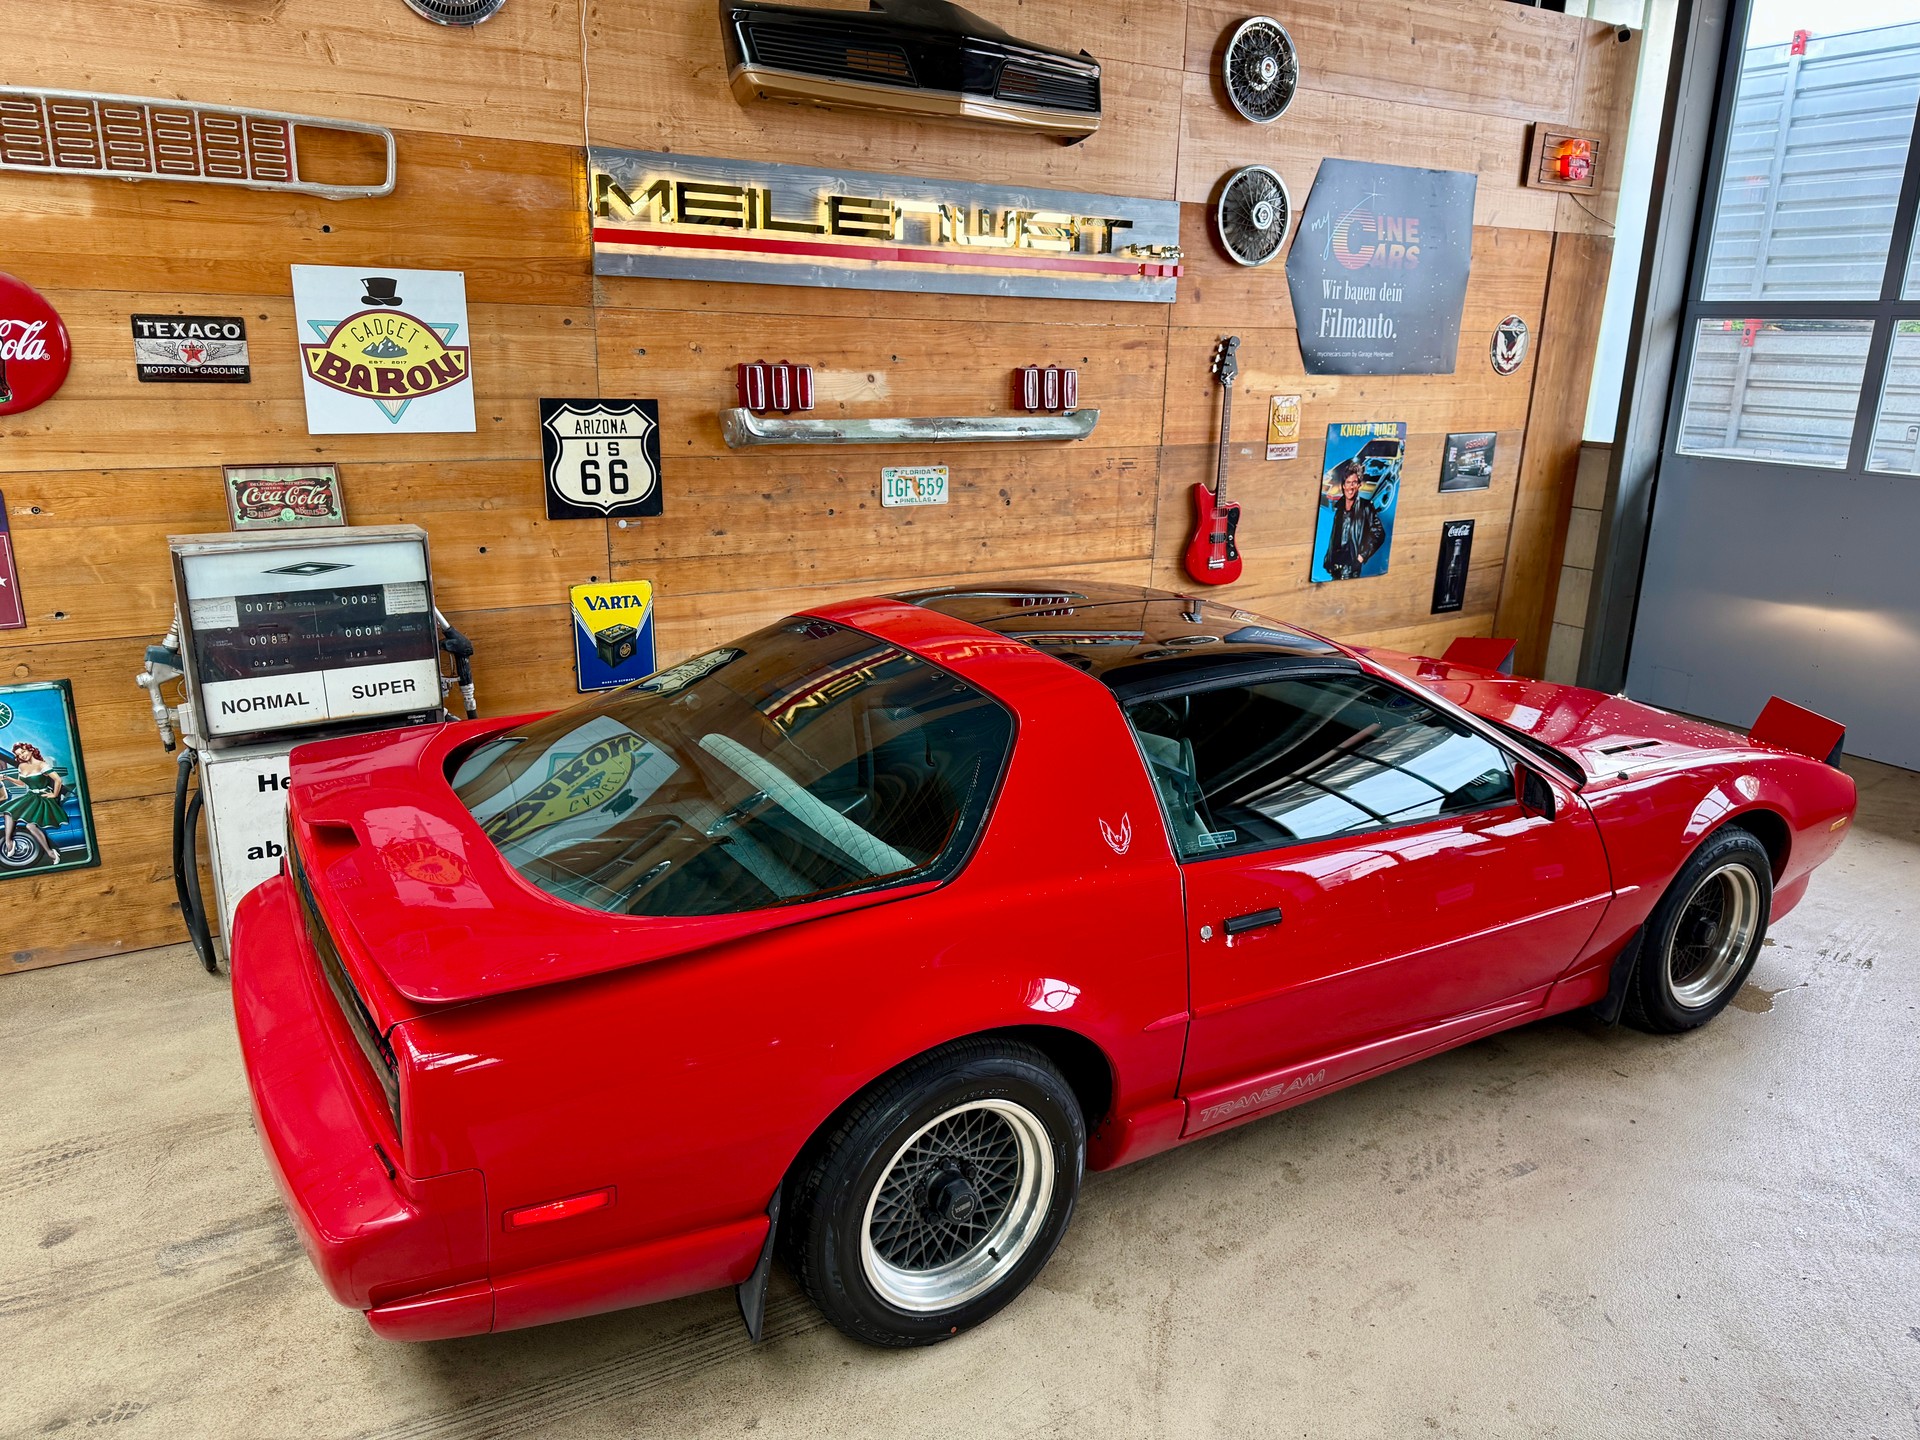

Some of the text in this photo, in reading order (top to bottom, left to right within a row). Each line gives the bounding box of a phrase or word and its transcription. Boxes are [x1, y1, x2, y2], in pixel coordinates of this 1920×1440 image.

[1322, 279, 1403, 302] Wir bauen dein
[137, 320, 241, 339] TEXACO
[351, 318, 420, 344] GADGET
[1319, 308, 1398, 339] Filmauto.
[143, 366, 245, 375] MOTOR OIL GASOLINE
[314, 350, 464, 395] BARON
[575, 419, 628, 435] ARIZONA
[1277, 414, 1296, 423] SHELL
[1340, 423, 1371, 437] KNIGHT
[580, 459, 629, 496] 66
[900, 468, 931, 476] FLORIDA
[887, 477, 944, 498] IGF 559
[341, 595, 368, 606] 000
[583, 594, 643, 611] VARTA
[351, 678, 416, 701] SUPER
[221, 691, 310, 715] NORMAL
[1200, 1068, 1326, 1122] TRANS AM
